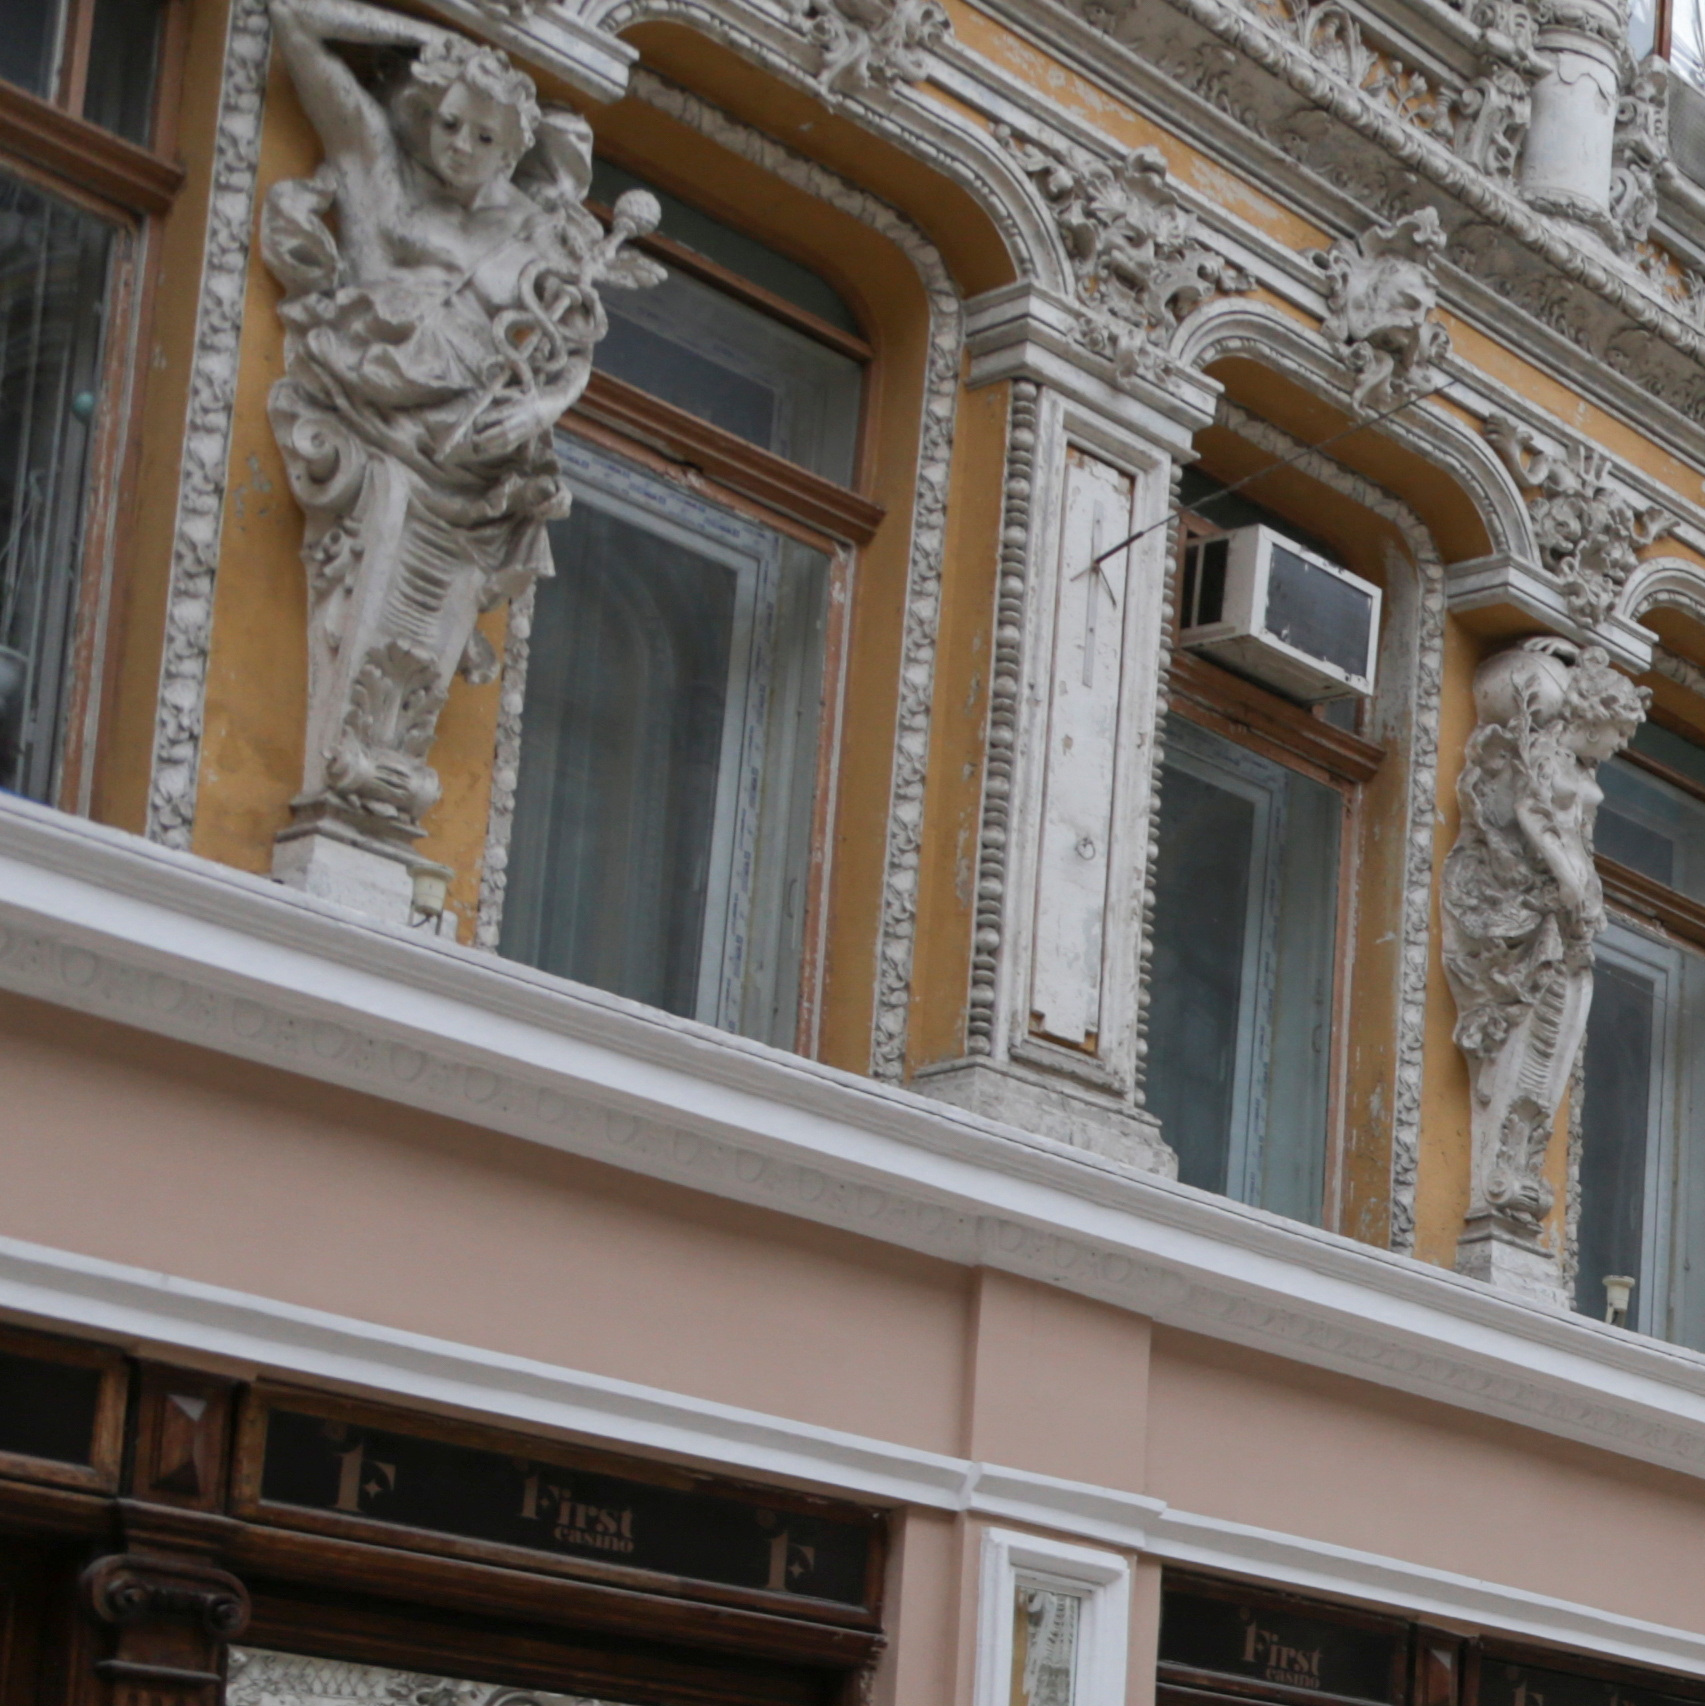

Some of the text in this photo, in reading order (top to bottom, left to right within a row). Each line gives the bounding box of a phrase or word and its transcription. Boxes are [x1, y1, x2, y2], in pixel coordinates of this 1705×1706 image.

[519, 1473, 634, 1538] First
[554, 1526, 634, 1552] casino
[1241, 1620, 1323, 1676] First
[1265, 1667, 1321, 1689] casino
